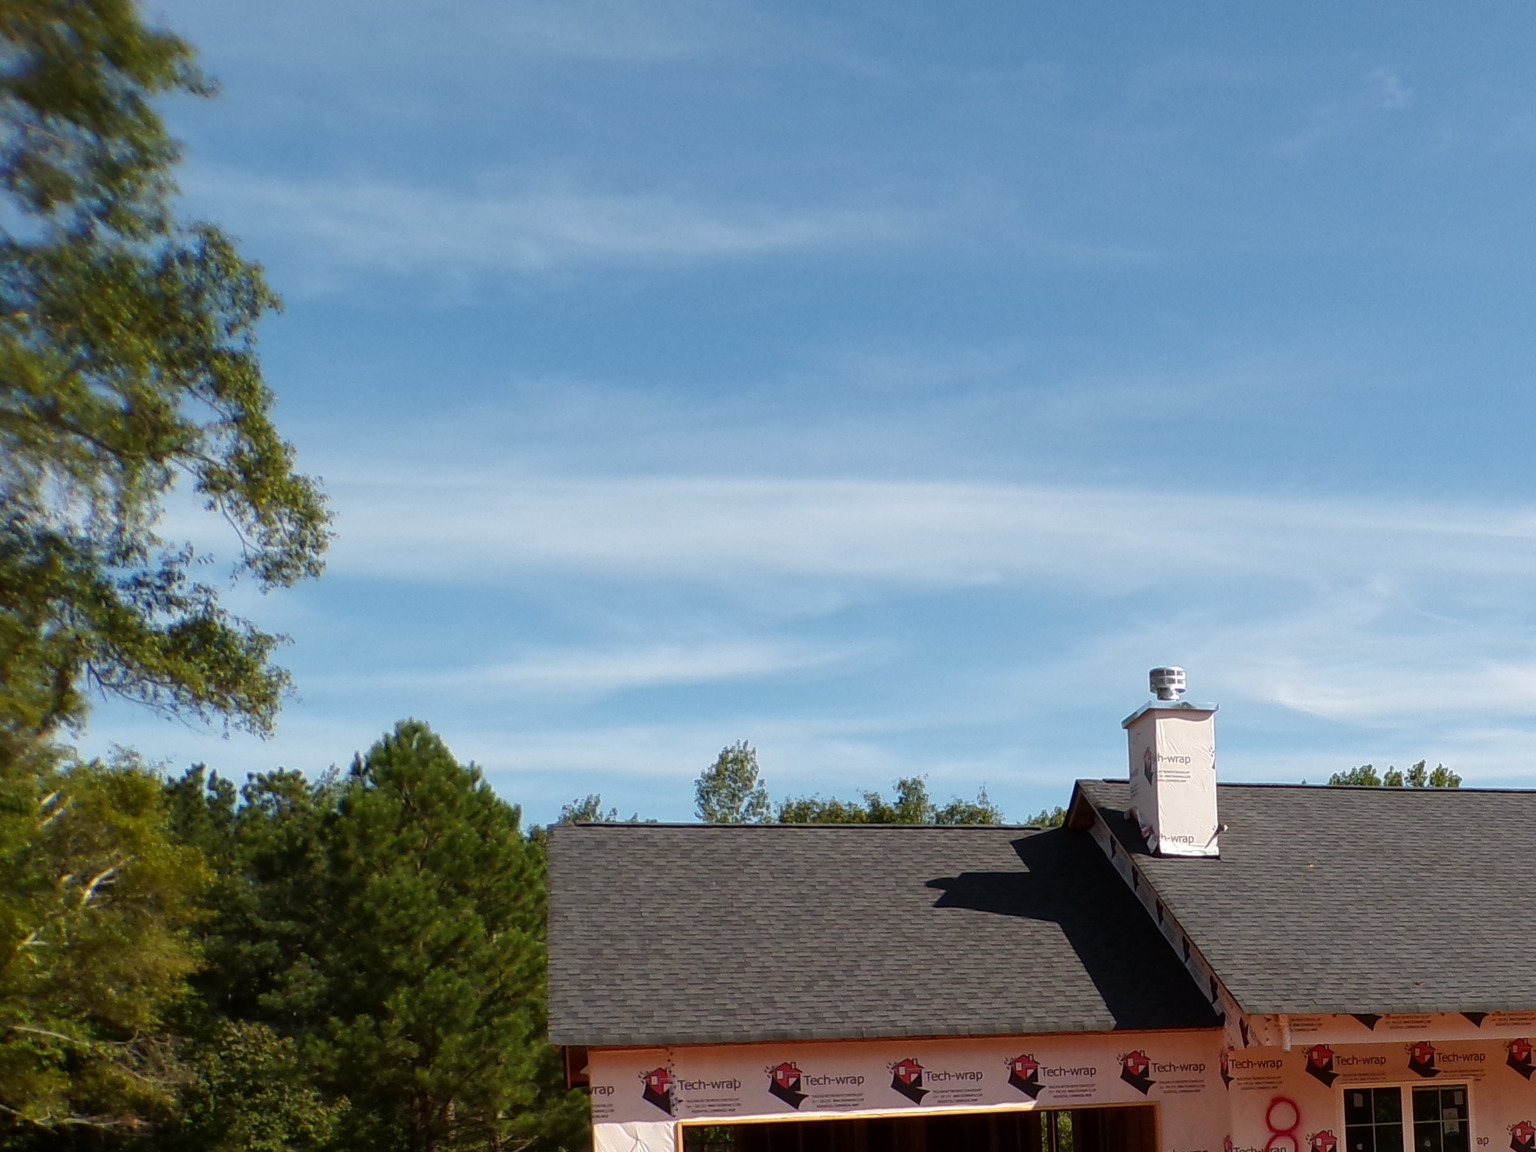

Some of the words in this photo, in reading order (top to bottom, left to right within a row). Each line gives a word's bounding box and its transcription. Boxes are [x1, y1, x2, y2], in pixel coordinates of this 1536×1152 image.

[1229, 1057, 1283, 1070] Tech-wrap
[1336, 1054, 1387, 1067] Tech-wrap
[1438, 1052, 1486, 1063] Tech-wrap
[1040, 1065, 1097, 1080] Tech-wrap
[1151, 1060, 1206, 1075] Tech-wrap
[803, 1074, 865, 1088] Tech-wrap
[924, 1069, 984, 1084] Tech-wrap
[677, 1079, 741, 1092] Tech-wrap
